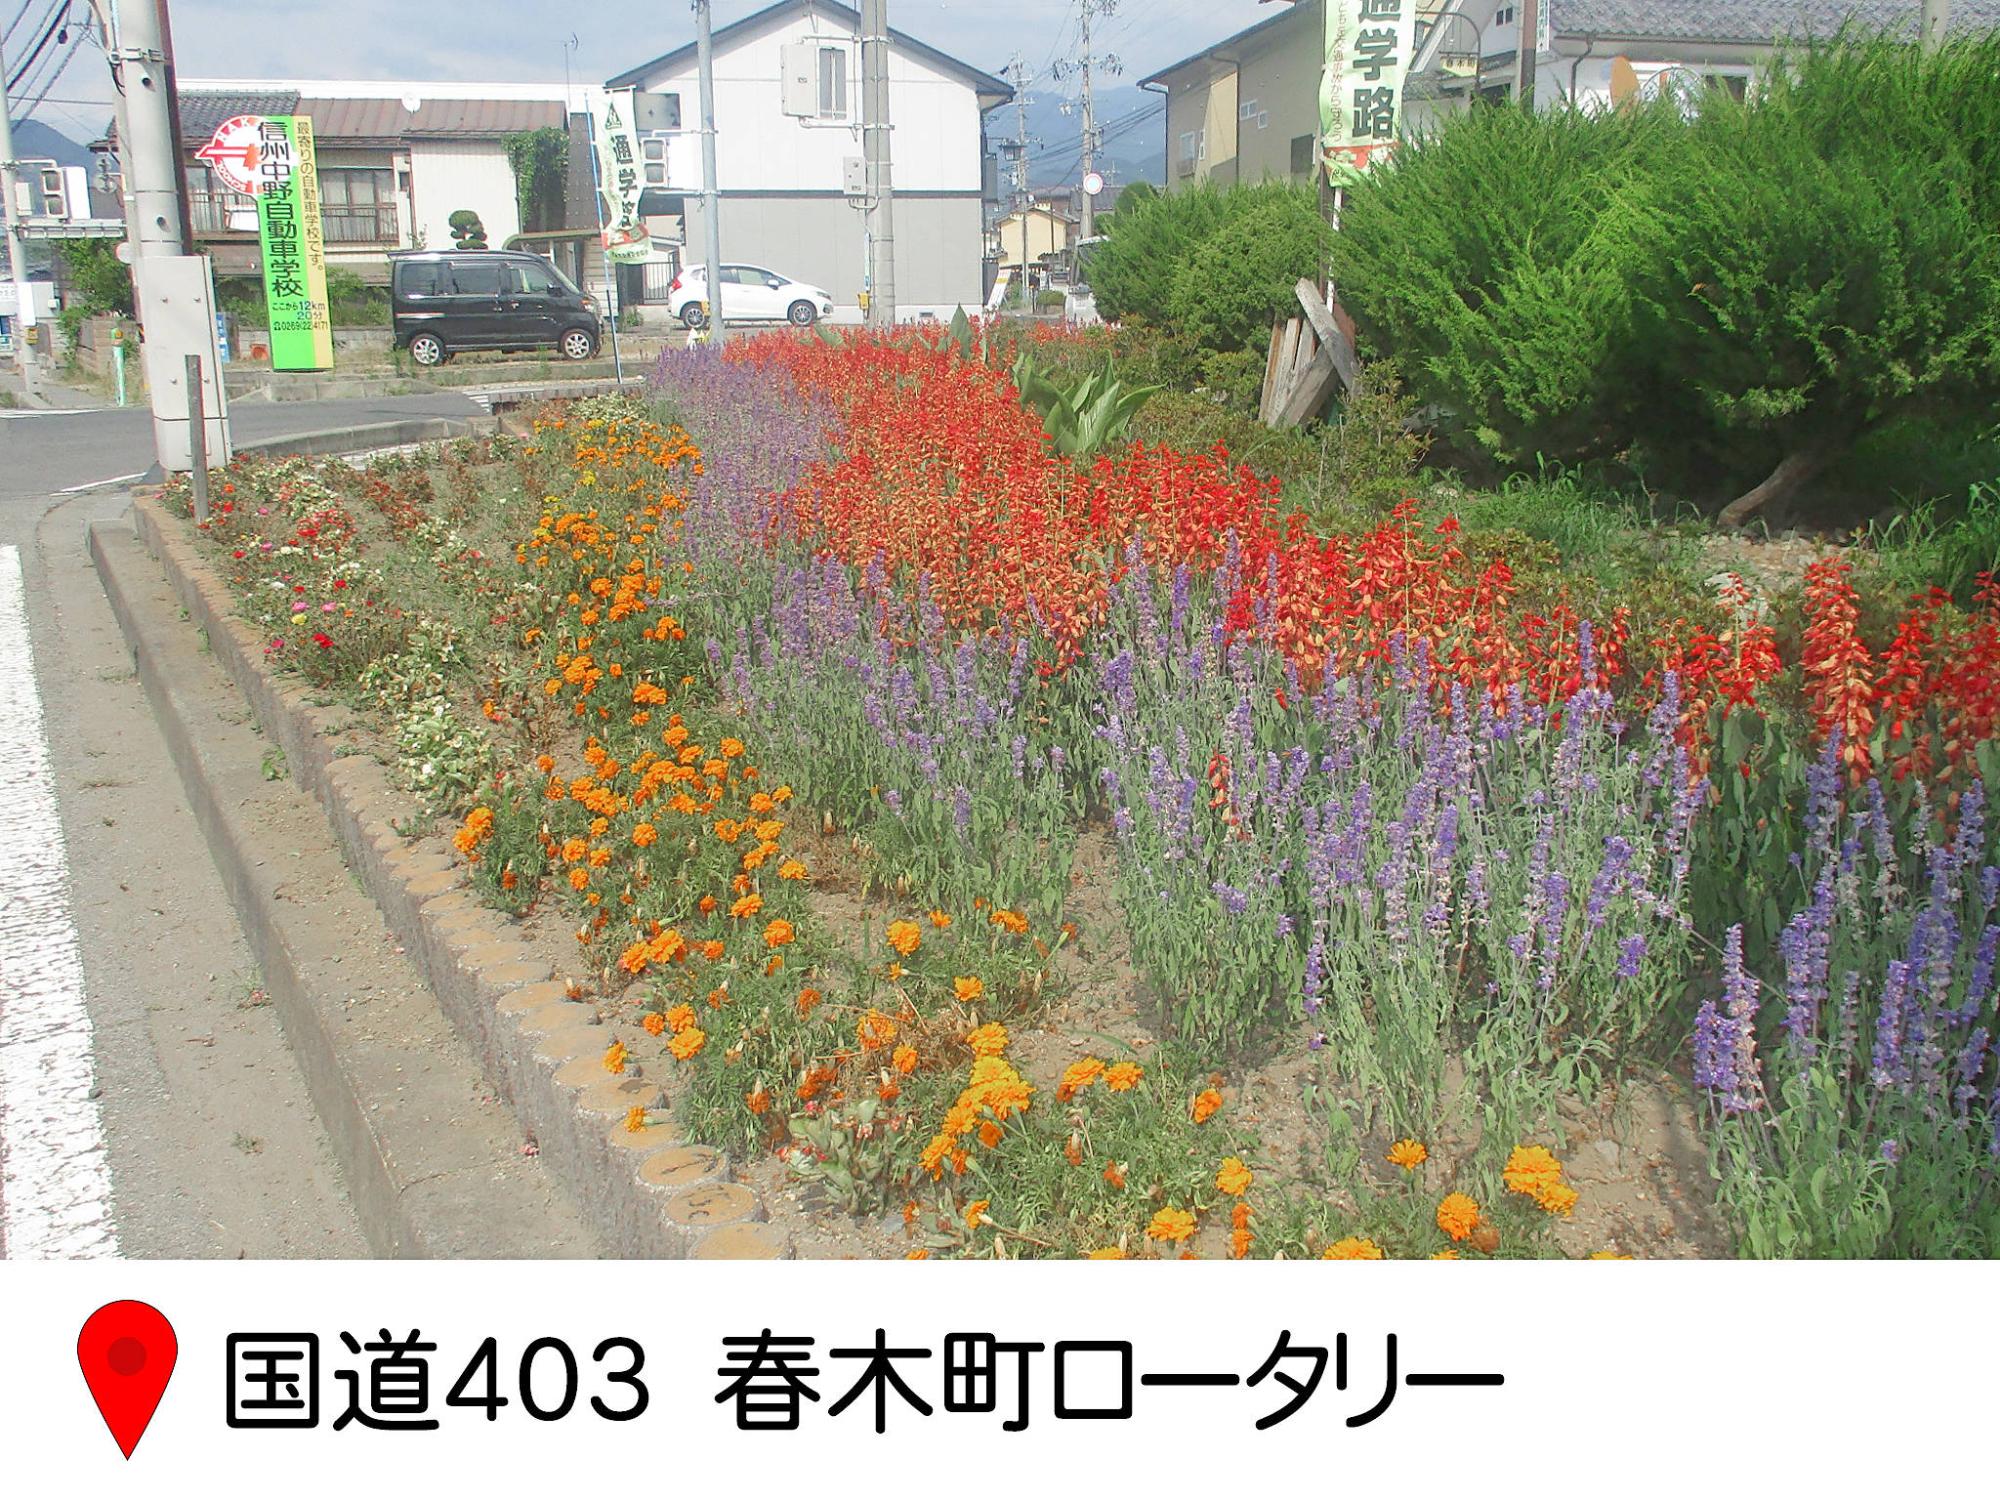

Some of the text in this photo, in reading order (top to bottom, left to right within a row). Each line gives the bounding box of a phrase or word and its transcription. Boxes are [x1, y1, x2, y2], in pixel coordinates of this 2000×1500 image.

[258, 121, 304, 298] 信州中野自動車学校
[297, 121, 323, 271] 最寄りの自動車学校です。
